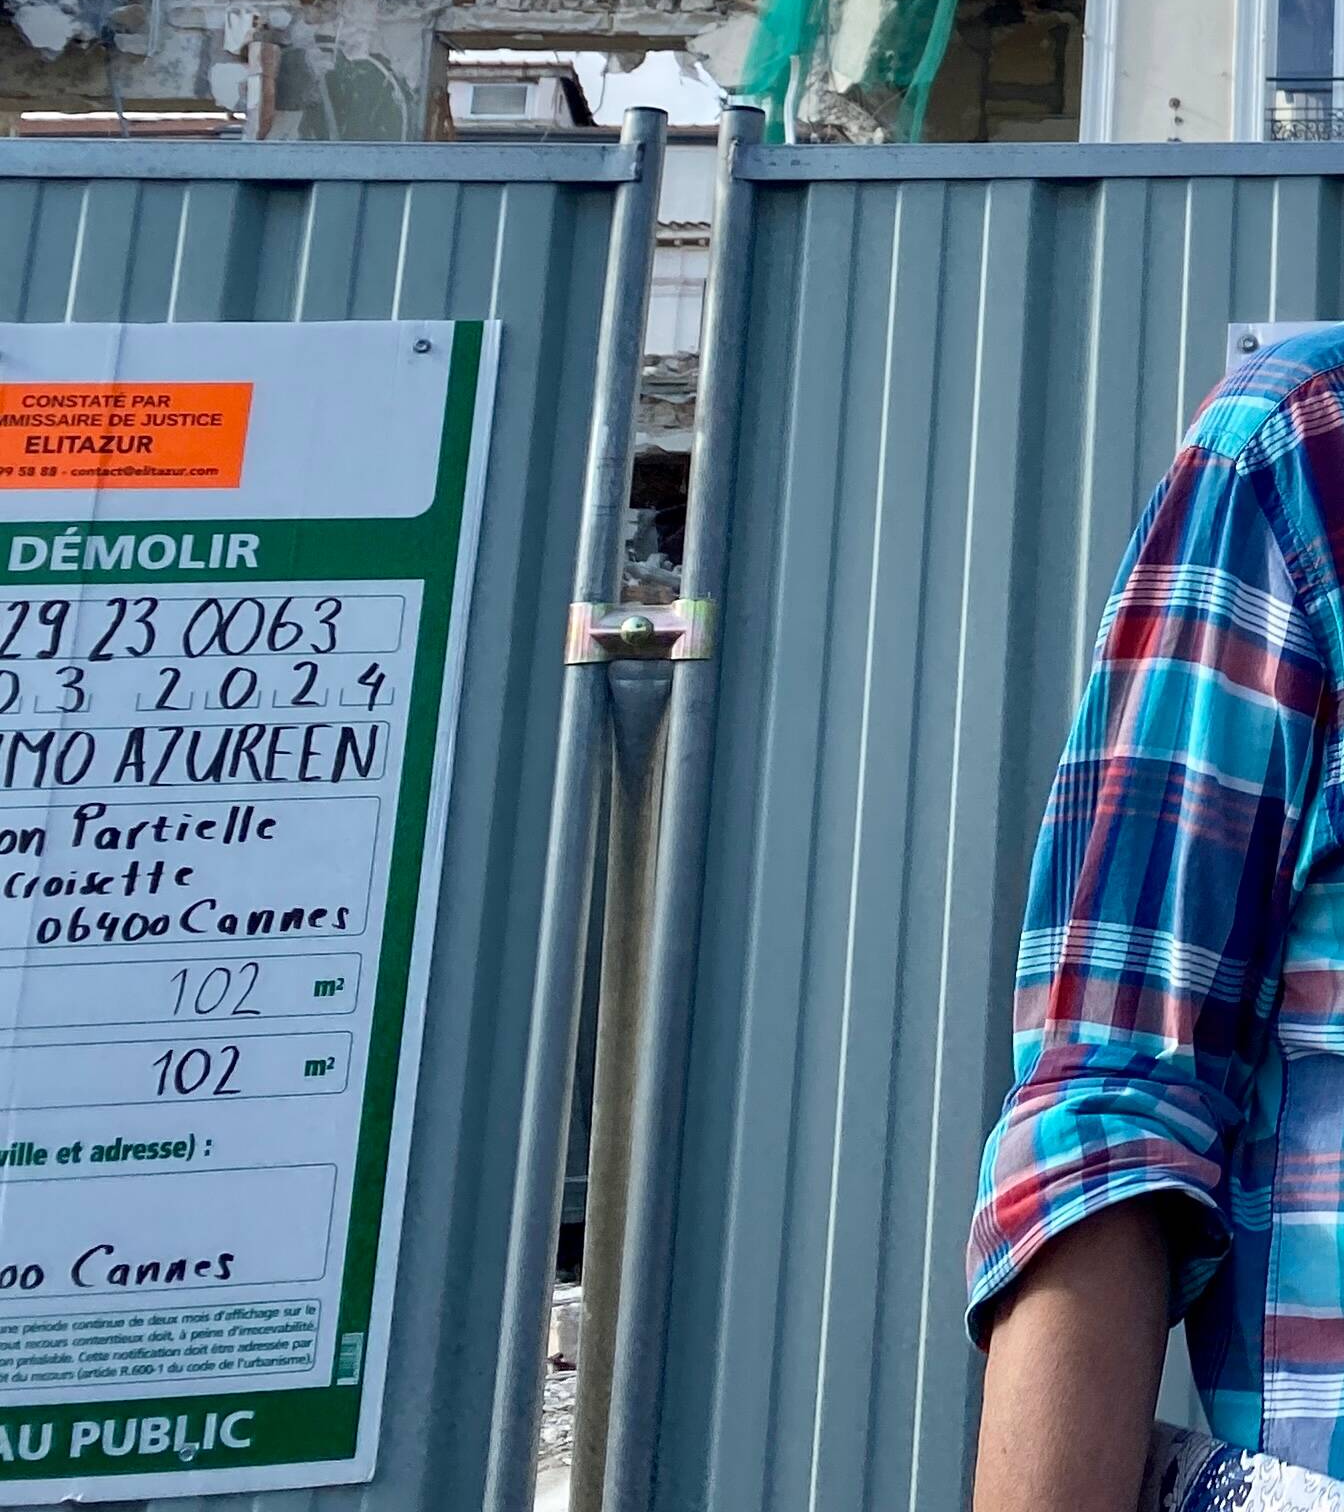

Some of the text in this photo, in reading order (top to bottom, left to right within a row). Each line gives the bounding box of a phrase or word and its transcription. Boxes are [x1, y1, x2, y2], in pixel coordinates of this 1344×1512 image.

[22, 392, 170, 408] CONSTATÉ PAR
[108, 414, 135, 426] DE
[141, 413, 223, 426] JUSTICE
[25, 435, 153, 454] ELITAZUR
[70, 464, 219, 477] contact@elitazur.com
[8, 527, 260, 572] DÉMOLIR
[89, 597, 158, 661] 23
[183, 598, 342, 656] 0063
[0, 723, 378, 788] MO AZUREEN
[71, 802, 277, 850] Partielle
[36, 899, 350, 944] 06400 Cannes
[170, 962, 261, 1016] 102
[152, 1045, 241, 1096] 102
[56, 1141, 83, 1164] et
[90, 1133, 196, 1162] adresse)
[71, 1244, 235, 1287] Cannes
[128, 1315, 144, 1327] de
[147, 1313, 178, 1326] deux
[181, 1311, 210, 1324] mois
[284, 1306, 302, 1318] sur
[305, 1303, 316, 1316] le
[167, 1361, 184, 1373] du
[186, 1359, 216, 1372] code
[218, 1357, 234, 1370] de
[292, 1338, 313, 1350] par
[70, 1410, 254, 1458] PUBLIC
